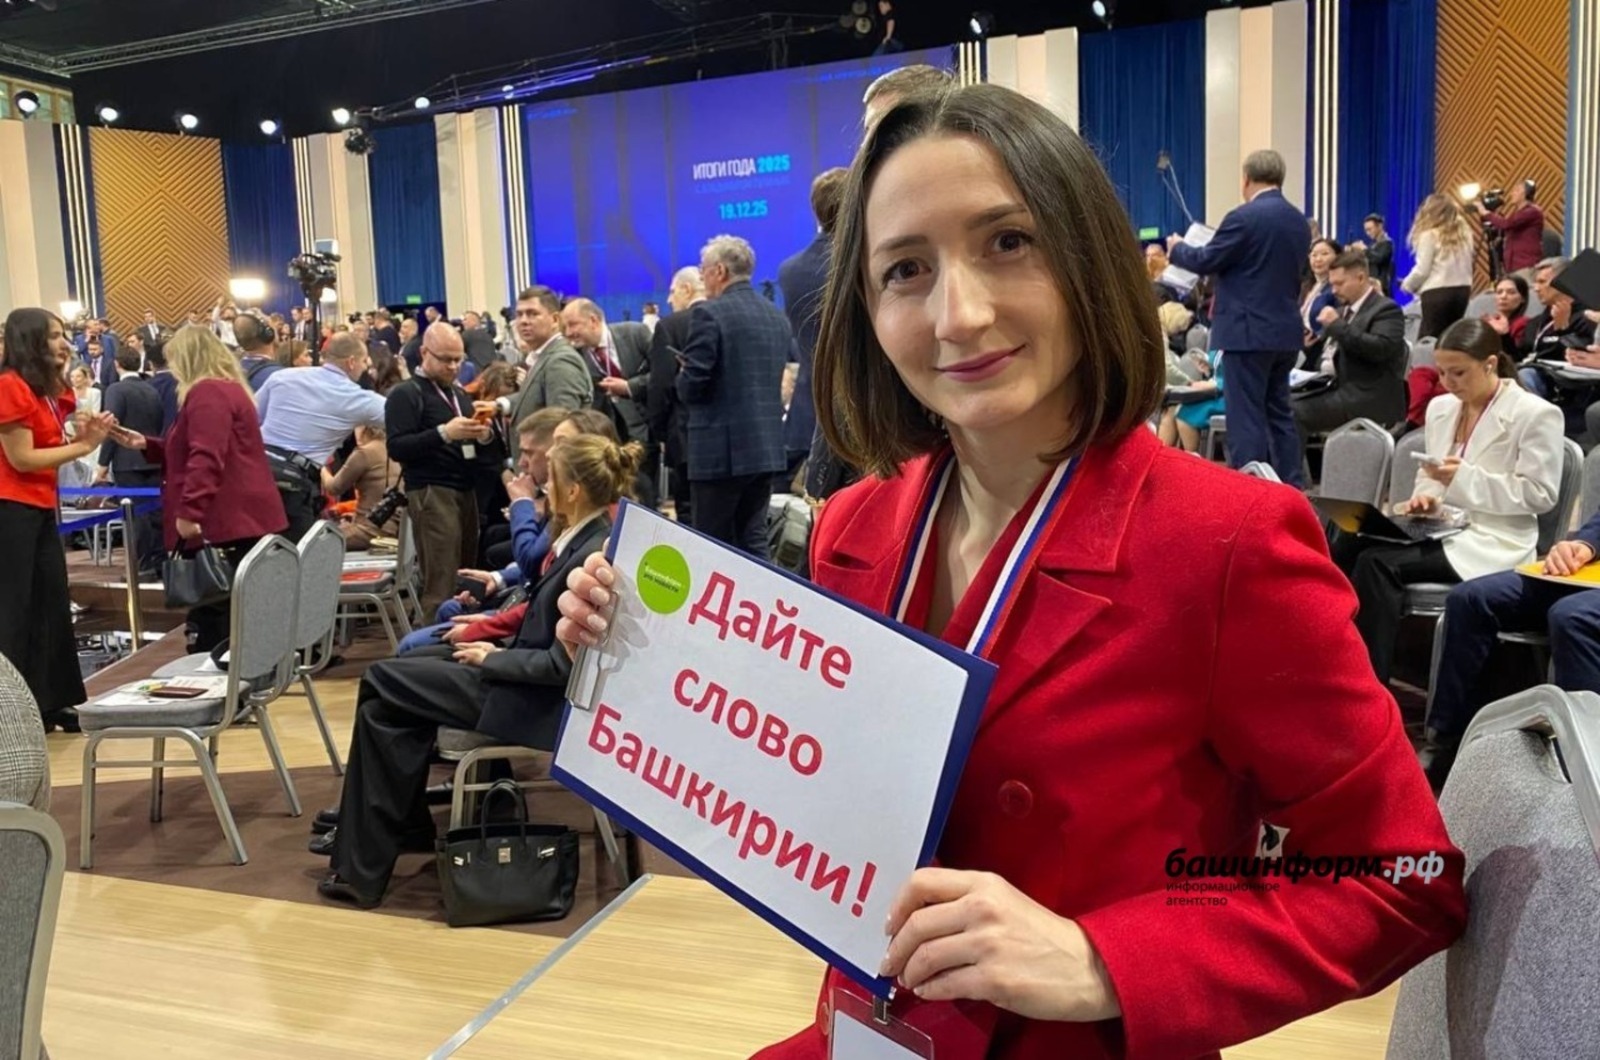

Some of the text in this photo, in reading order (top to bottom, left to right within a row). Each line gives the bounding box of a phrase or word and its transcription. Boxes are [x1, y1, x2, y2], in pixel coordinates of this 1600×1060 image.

[693, 154, 790, 180] ИТОГИ ГОДА 2025
[719, 199, 768, 220] 19.12.25
[687, 572, 853, 689] Дайте
[673, 668, 823, 777] слово
[588, 703, 877, 923] Башкирии!
